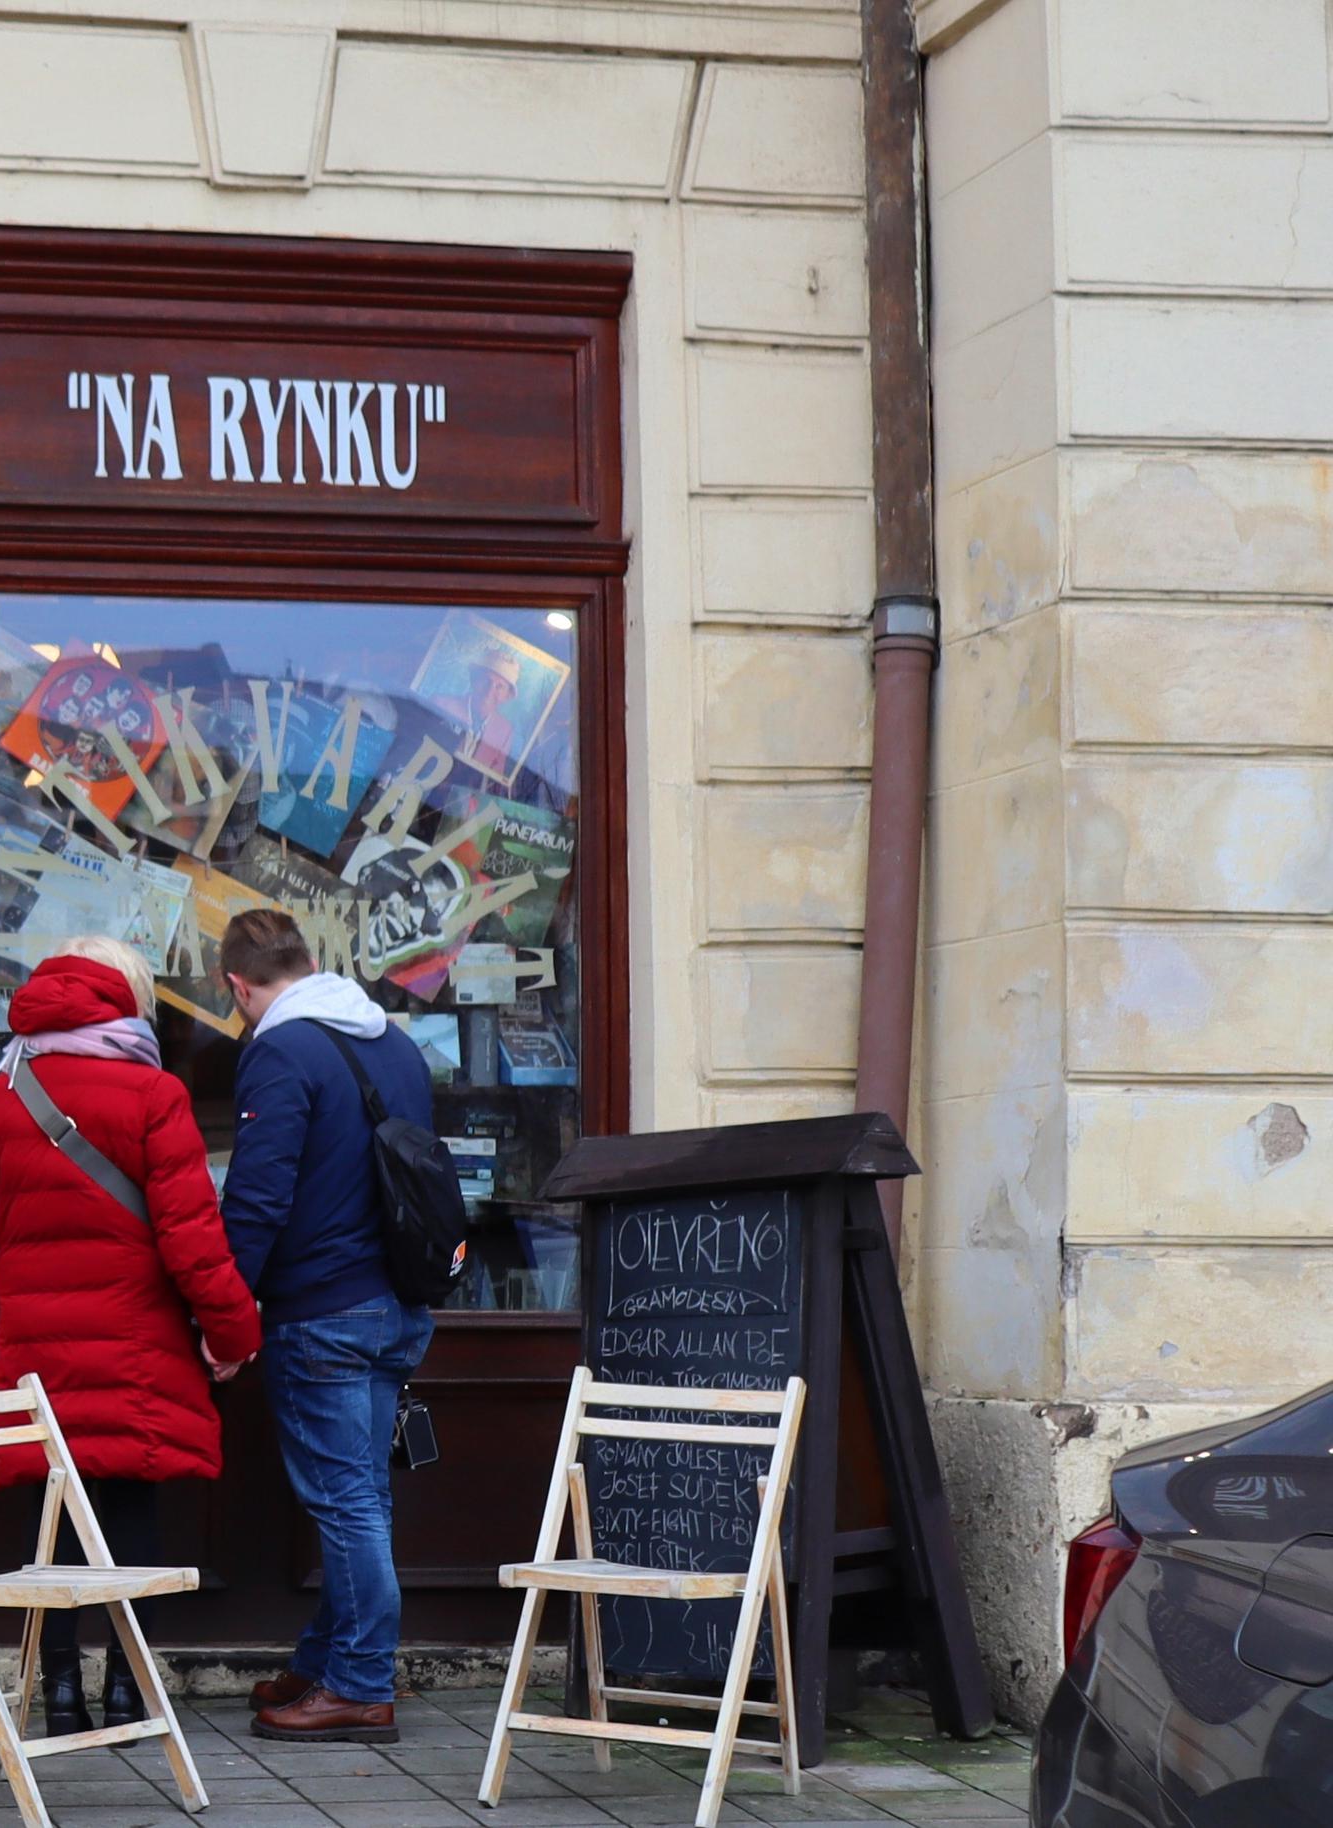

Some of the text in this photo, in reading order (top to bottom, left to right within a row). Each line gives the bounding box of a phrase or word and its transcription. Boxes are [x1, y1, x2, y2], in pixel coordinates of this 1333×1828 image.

[68, 371, 446, 491] "NA RYNKU"
[494, 818, 574, 853] PLANETARIUM
[623, 1286, 760, 1317] GRAMODESKY
[601, 1328, 790, 1366] EDGAR ALLAN POE
[734, 1448, 769, 1483] VER
[598, 1470, 753, 1516] JOSEF SUDEK
